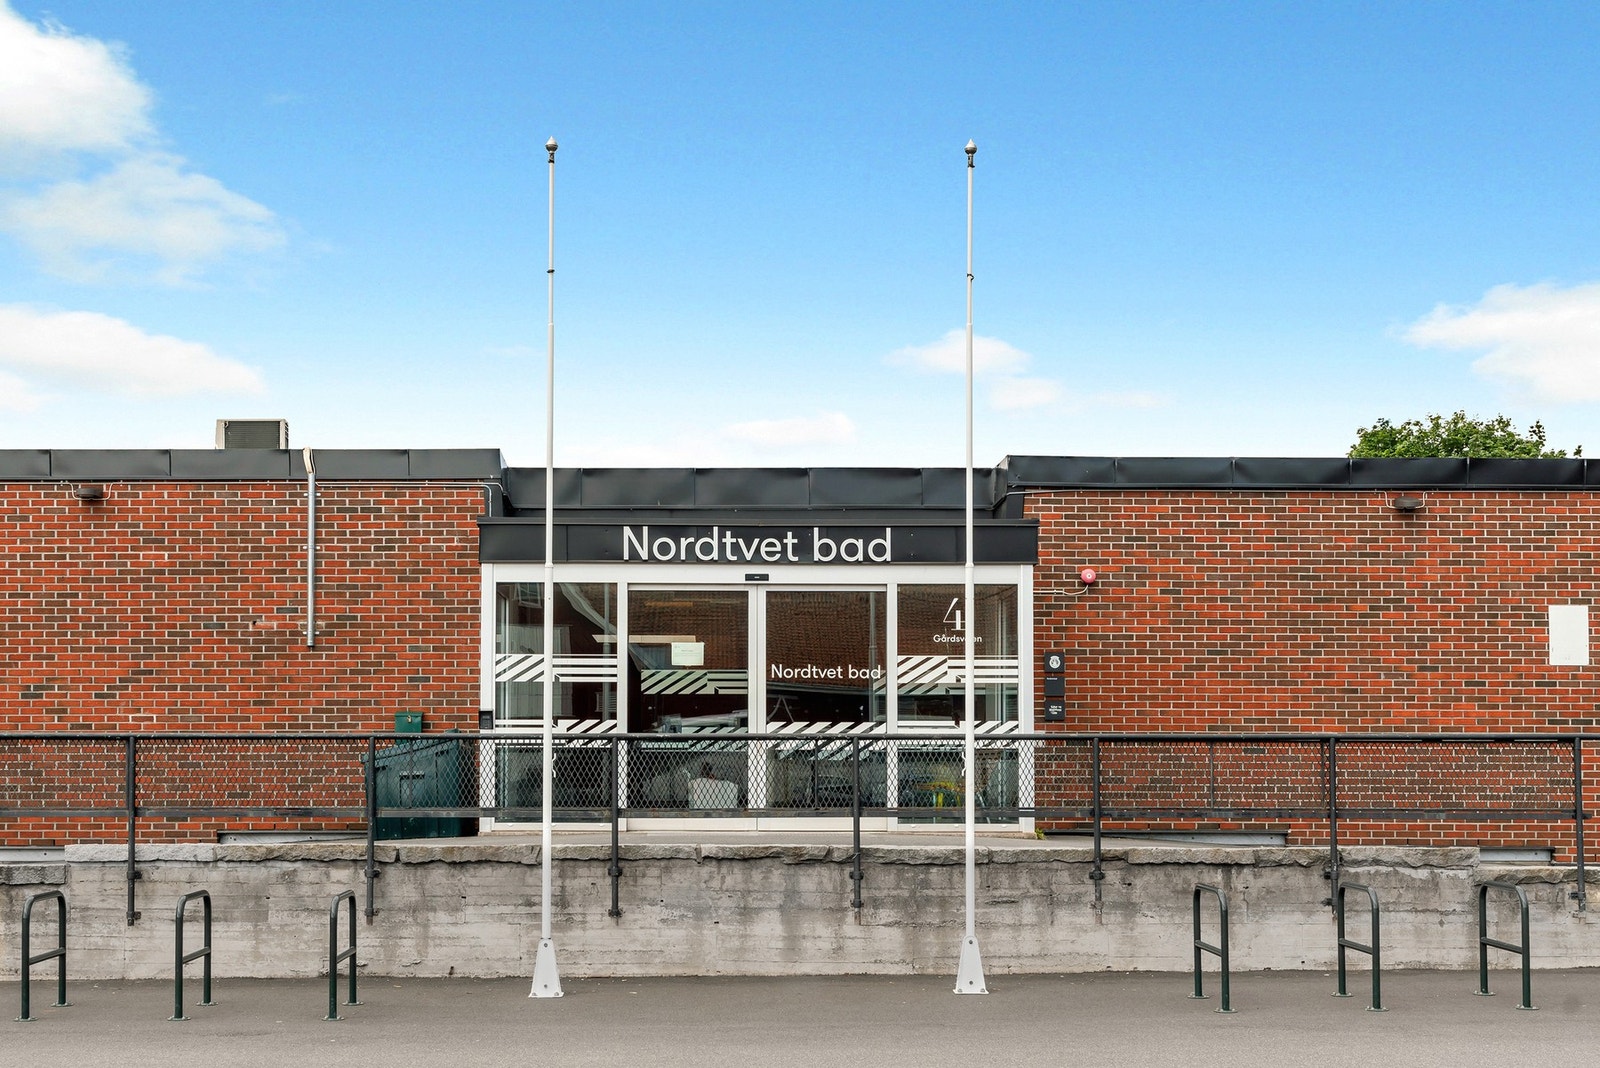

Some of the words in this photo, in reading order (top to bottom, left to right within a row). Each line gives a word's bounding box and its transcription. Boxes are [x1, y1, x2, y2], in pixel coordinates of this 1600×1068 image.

[623, 526, 798, 562] Nordtvet
[813, 527, 891, 562] bad
[943, 597, 967, 631] 4
[771, 664, 843, 680] Nordtvet
[848, 665, 882, 681] bad
